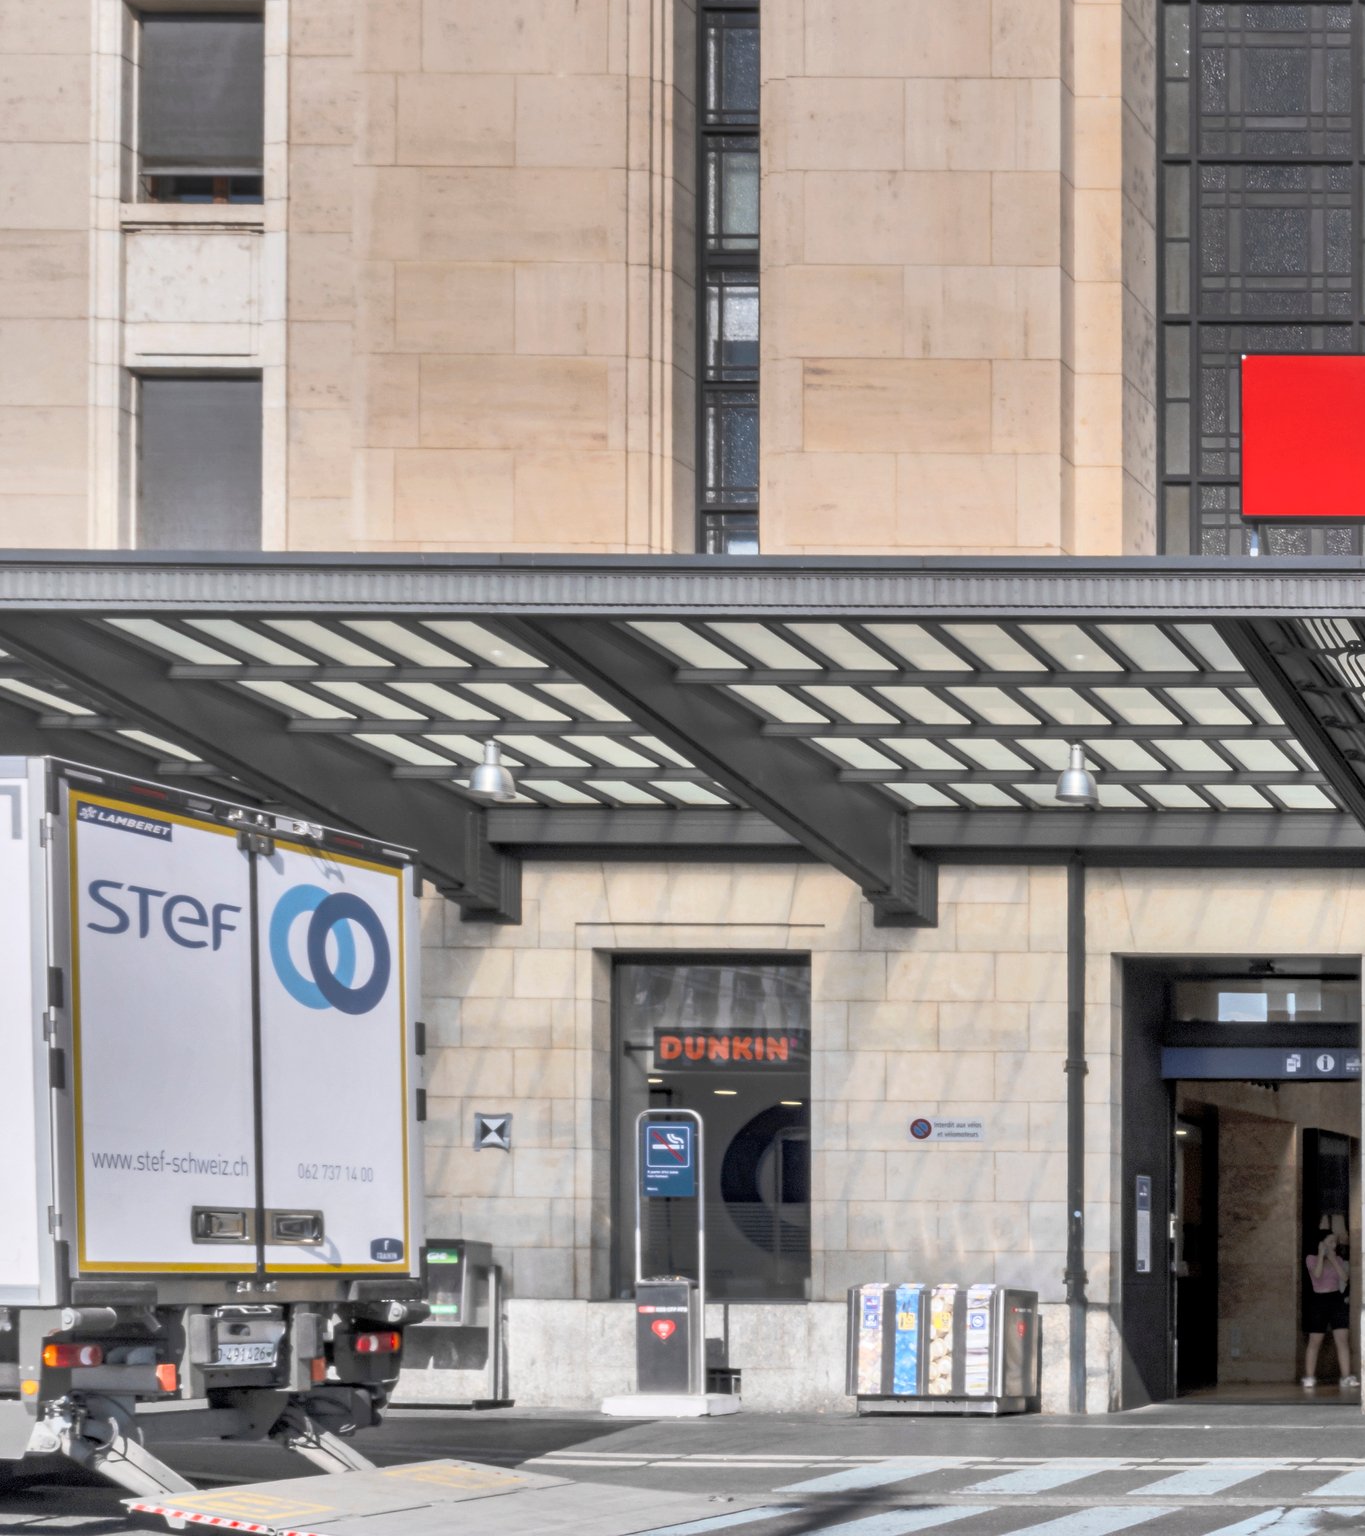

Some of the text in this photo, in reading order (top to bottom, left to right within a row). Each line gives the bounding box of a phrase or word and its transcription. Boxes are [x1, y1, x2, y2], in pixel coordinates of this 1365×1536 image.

[98, 812, 170, 835] LAMBERET
[92, 1150, 249, 1176] www.stef-schweiz.ch
[298, 1163, 374, 1182] 062 737 14 00
